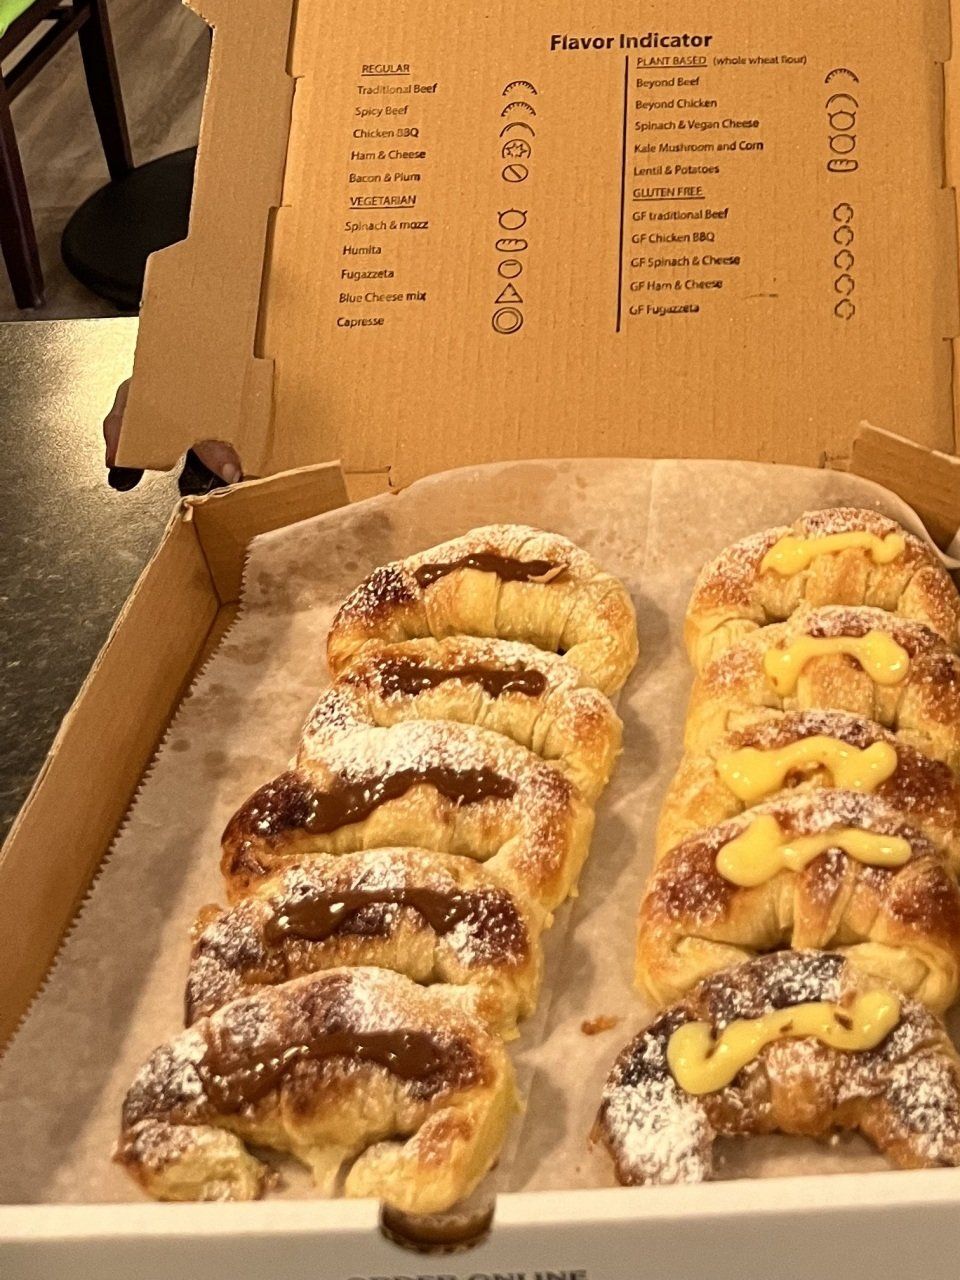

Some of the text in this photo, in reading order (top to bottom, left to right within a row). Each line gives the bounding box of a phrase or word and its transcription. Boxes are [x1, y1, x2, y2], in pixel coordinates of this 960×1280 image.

[550, 32, 713, 51] Flavor Indicator
[637, 57, 669, 67] PLANT
[673, 56, 707, 66] BASED
[713, 55, 747, 67] (whole
[361, 64, 410, 74] REGULAR
[636, 76, 700, 89] Beyond Beef
[357, 83, 438, 95] Traditional Beef
[635, 98, 717, 111] Beyond Chicken
[355, 105, 408, 118] Spicy Beef
[635, 120, 676, 132] Spinach
[688, 120, 720, 131] Vegan
[722, 119, 759, 129] Cheese
[353, 129, 394, 139] Chicken
[634, 141, 764, 153] Kale Mushroom and Corn
[351, 151, 375, 160] Ham
[388, 150, 427, 159] Cheese
[633, 165, 662, 176] Lentil
[674, 165, 720, 175] Potatoes
[348, 173, 381, 183] Bacon
[394, 172, 421, 181] Plum
[633, 186, 703, 198] GLUTEN FREE
[350, 195, 417, 206] VEGETARIAN
[632, 208, 729, 221] GF traditional Beef
[345, 221, 387, 233] Spinach
[631, 232, 715, 243] GF Chicken BBQ
[343, 245, 382, 255] Humita
[631, 258, 646, 267] GF
[648, 256, 690, 268] Spinach
[702, 255, 740, 265] Cheese
[341, 269, 394, 281] Fugazzeta
[630, 282, 645, 291] GF
[647, 281, 672, 290] Ham
[684, 279, 723, 289] Cheese
[339, 291, 427, 303] Blue Cheese mix
[337, 317, 384, 328] Capresse
